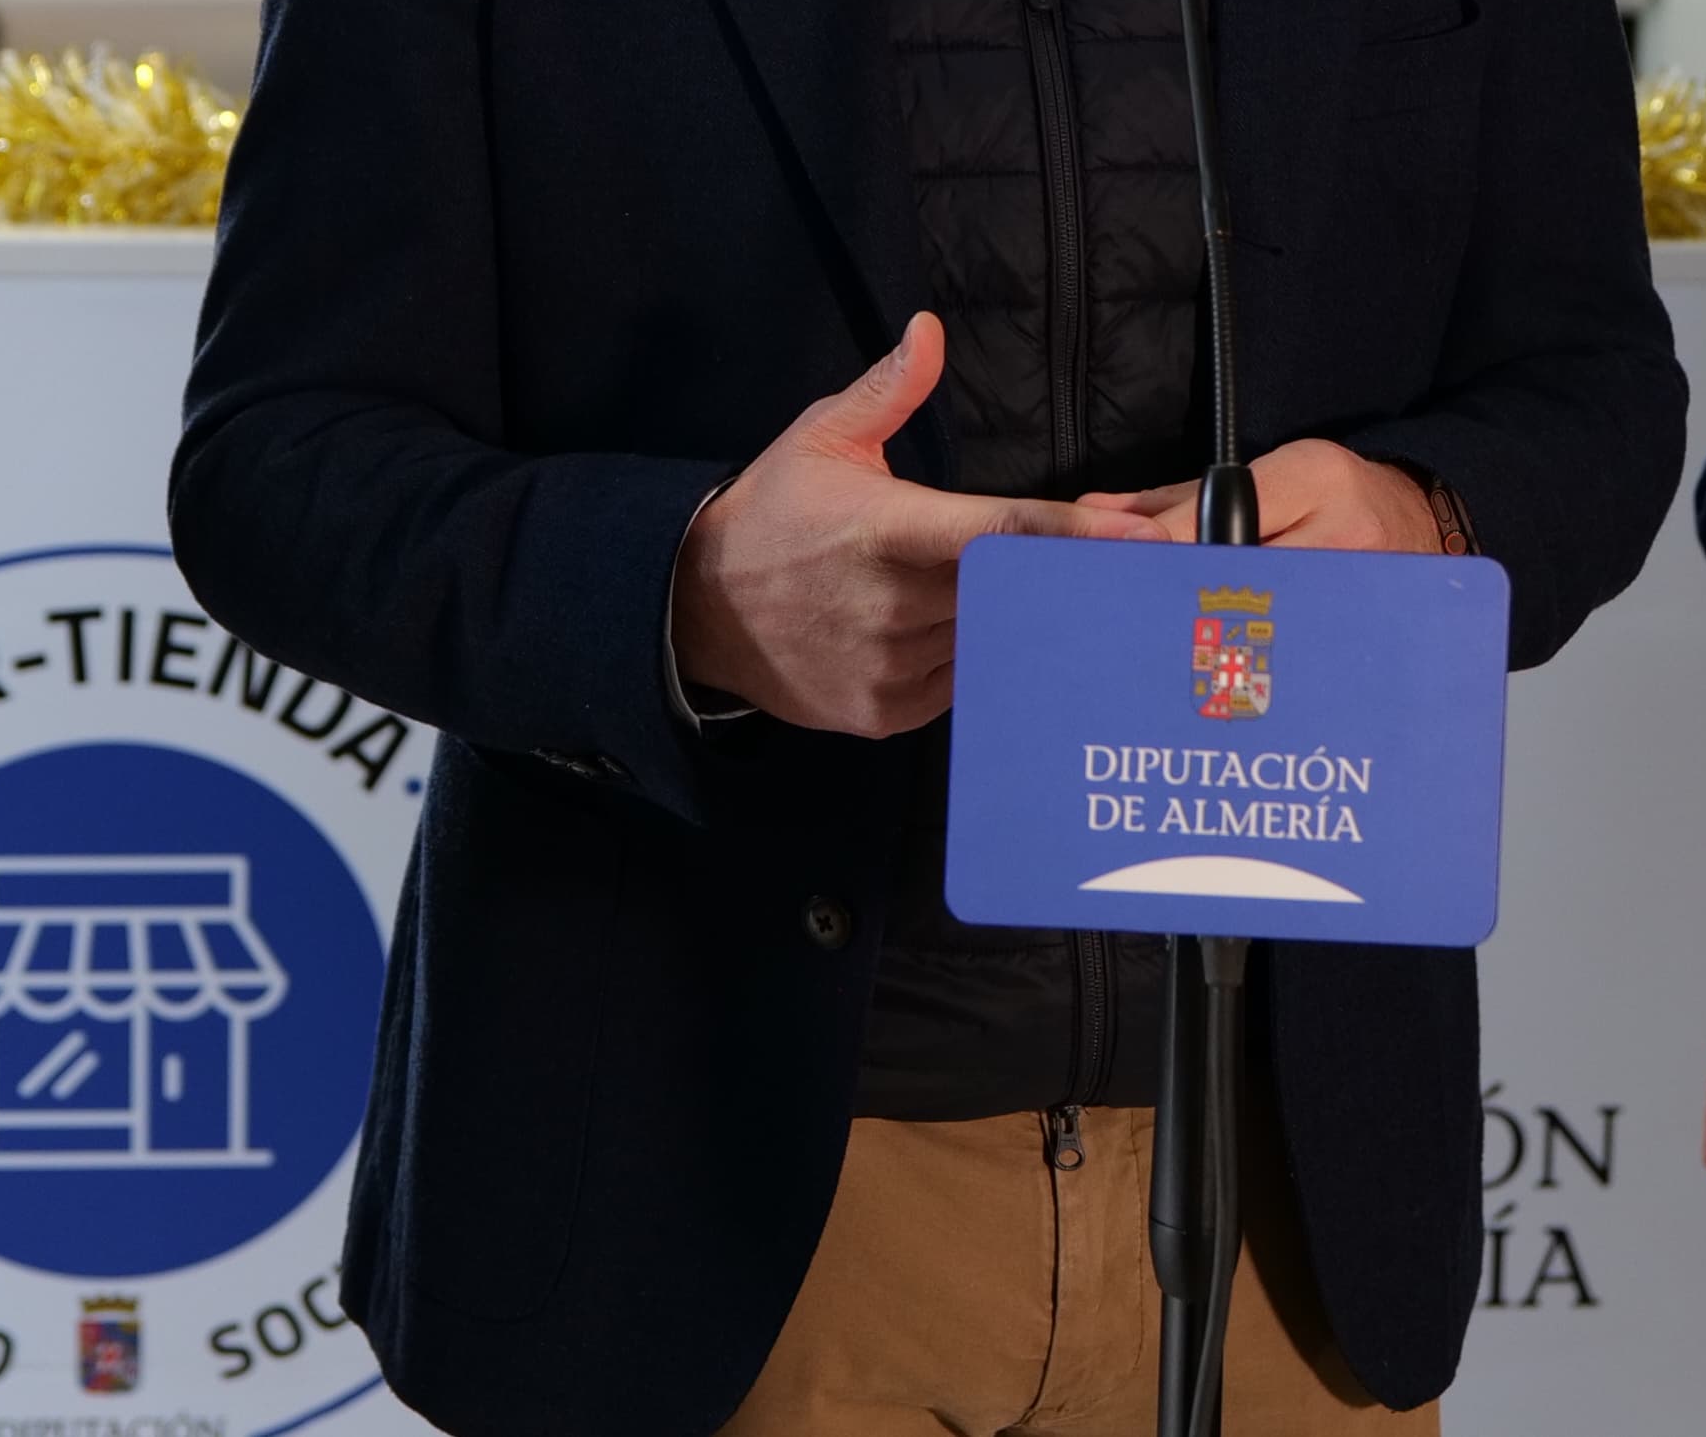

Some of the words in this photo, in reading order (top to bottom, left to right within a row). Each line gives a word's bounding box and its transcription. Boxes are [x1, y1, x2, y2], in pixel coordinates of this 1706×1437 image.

[1083, 744, 1373, 795] DIPUTACIÓN
[1086, 793, 1146, 833] DE
[1157, 794, 1364, 843] ALMERÍA
[207, 1263, 347, 1381] SOC
